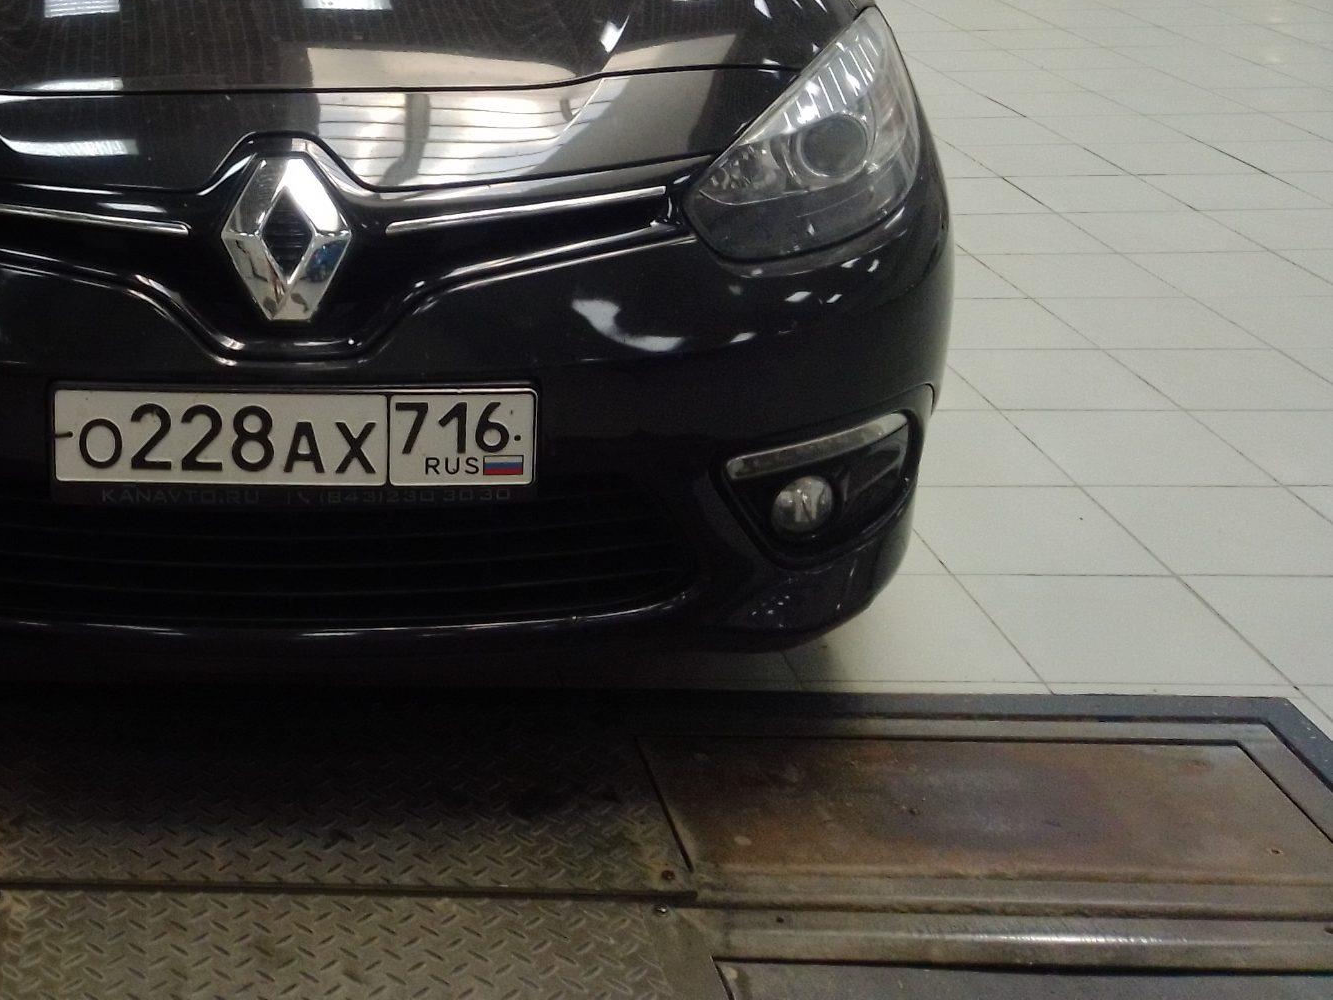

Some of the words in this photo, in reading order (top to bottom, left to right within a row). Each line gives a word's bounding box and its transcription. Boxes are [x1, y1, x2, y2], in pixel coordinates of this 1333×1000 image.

[395, 402, 510, 454] 716
[424, 456, 480, 476] RUS
[101, 487, 259, 504] KANAVTO.RU
